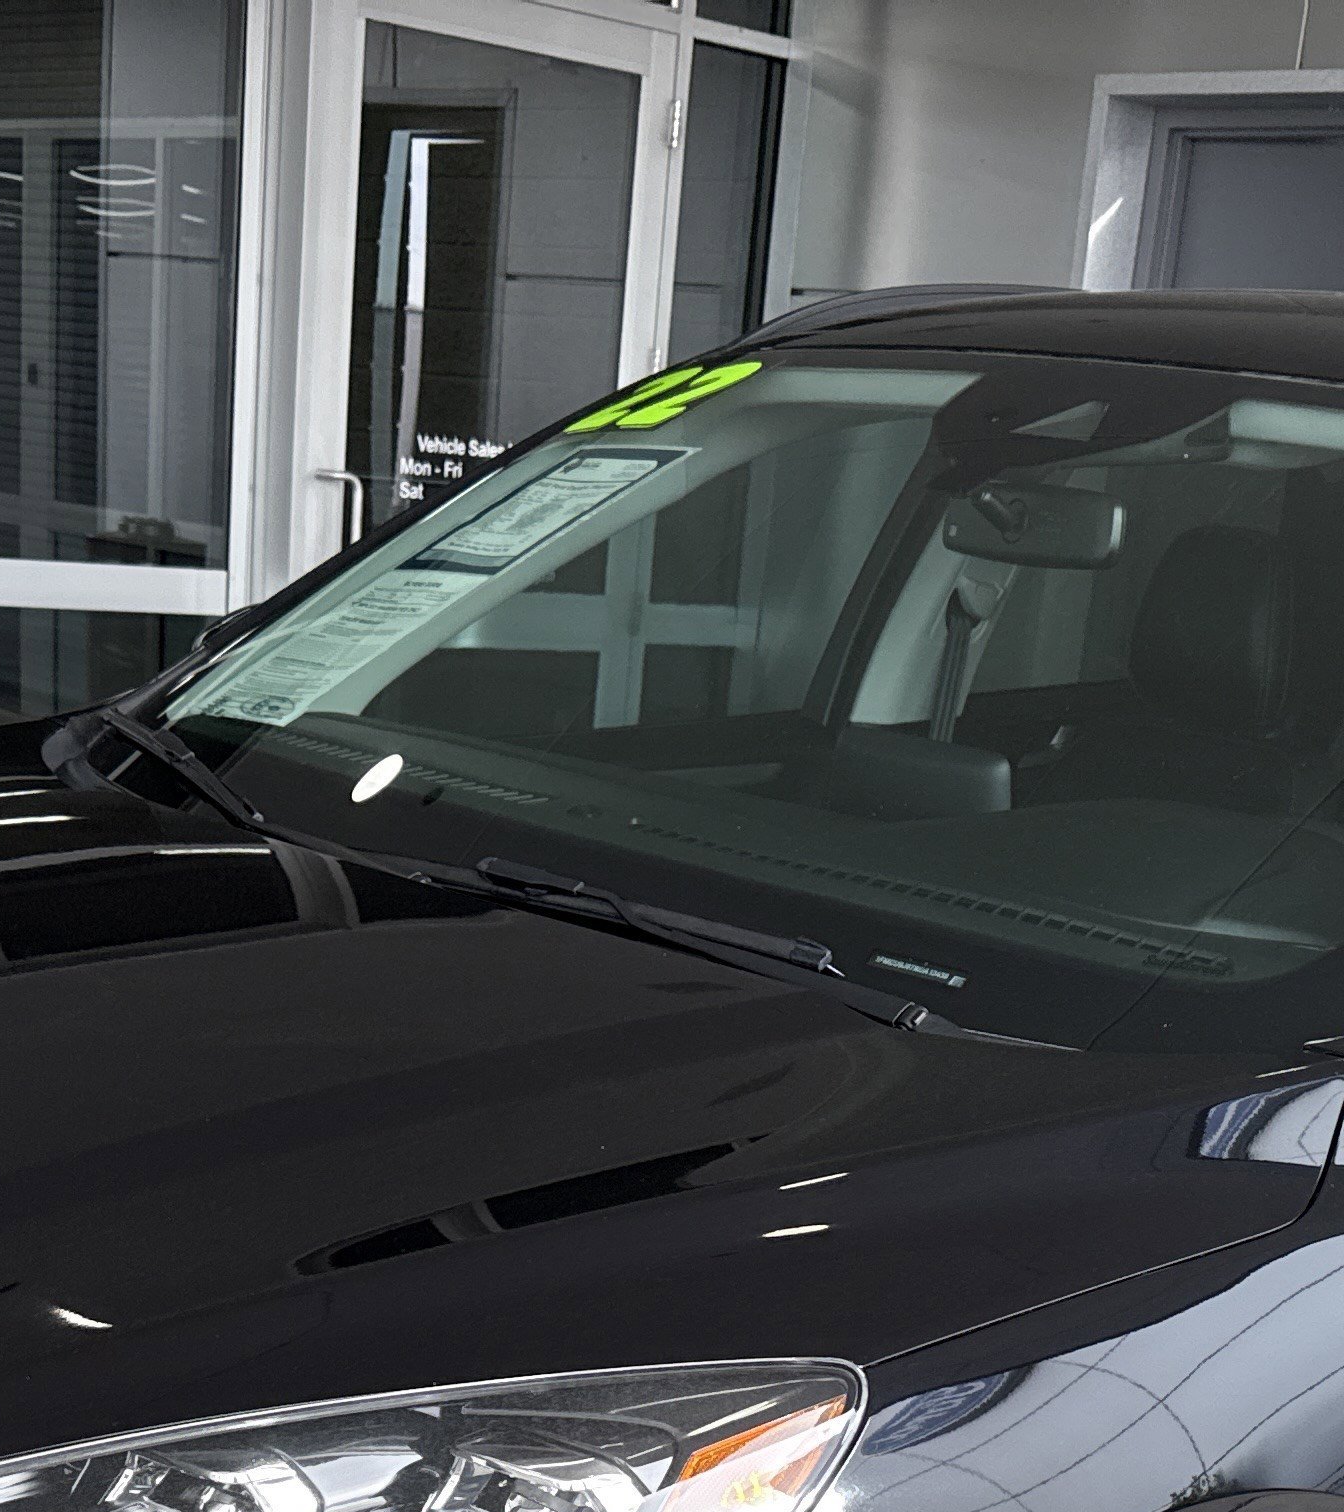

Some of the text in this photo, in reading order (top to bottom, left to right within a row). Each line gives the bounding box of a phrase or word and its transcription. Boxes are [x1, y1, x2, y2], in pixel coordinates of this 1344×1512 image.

[563, 361, 763, 434] 22
[416, 433, 466, 457] Vehicle
[399, 457, 431, 476] Mon
[444, 458, 463, 479] Fri
[399, 481, 424, 500] Sat
